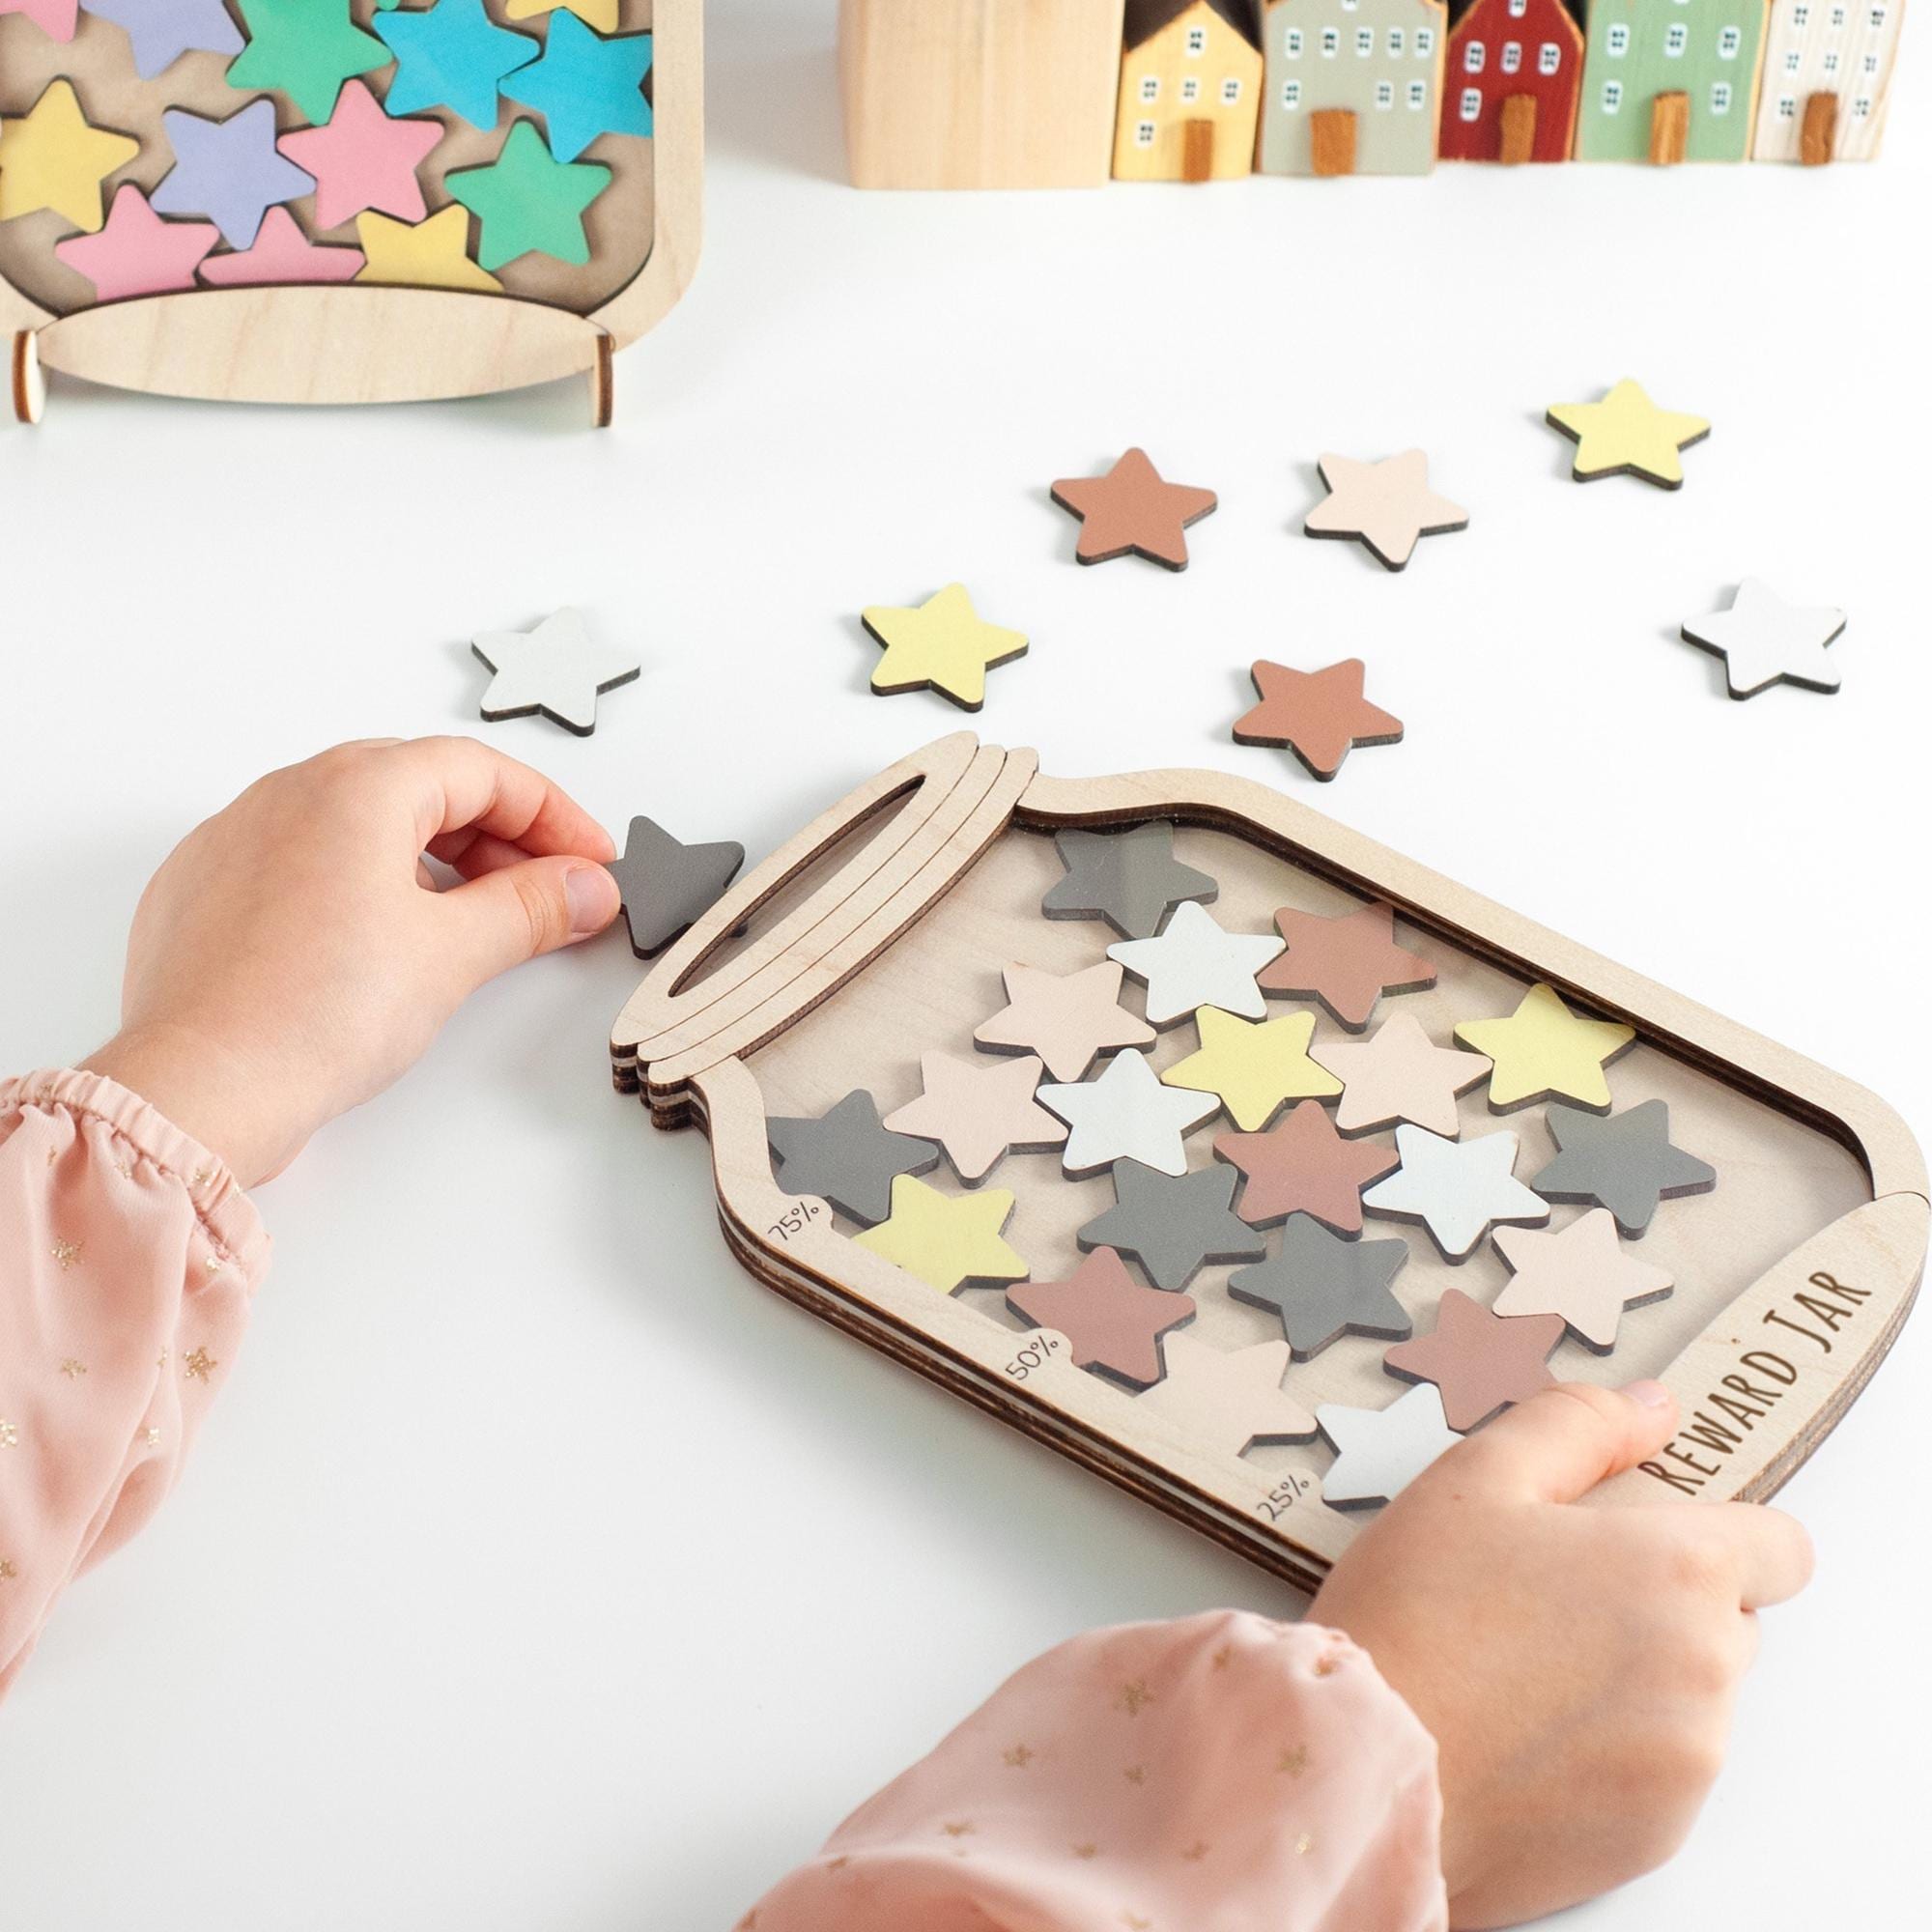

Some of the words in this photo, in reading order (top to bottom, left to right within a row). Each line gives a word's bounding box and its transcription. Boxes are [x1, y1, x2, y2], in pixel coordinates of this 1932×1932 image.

[767, 1201, 819, 1241] 75%
[1005, 1335, 1059, 1380] 50%
[1636, 1350, 1798, 1496] REWARD
[1763, 1270, 1873, 1353] JAR
[1256, 1474, 1310, 1521] 25%
